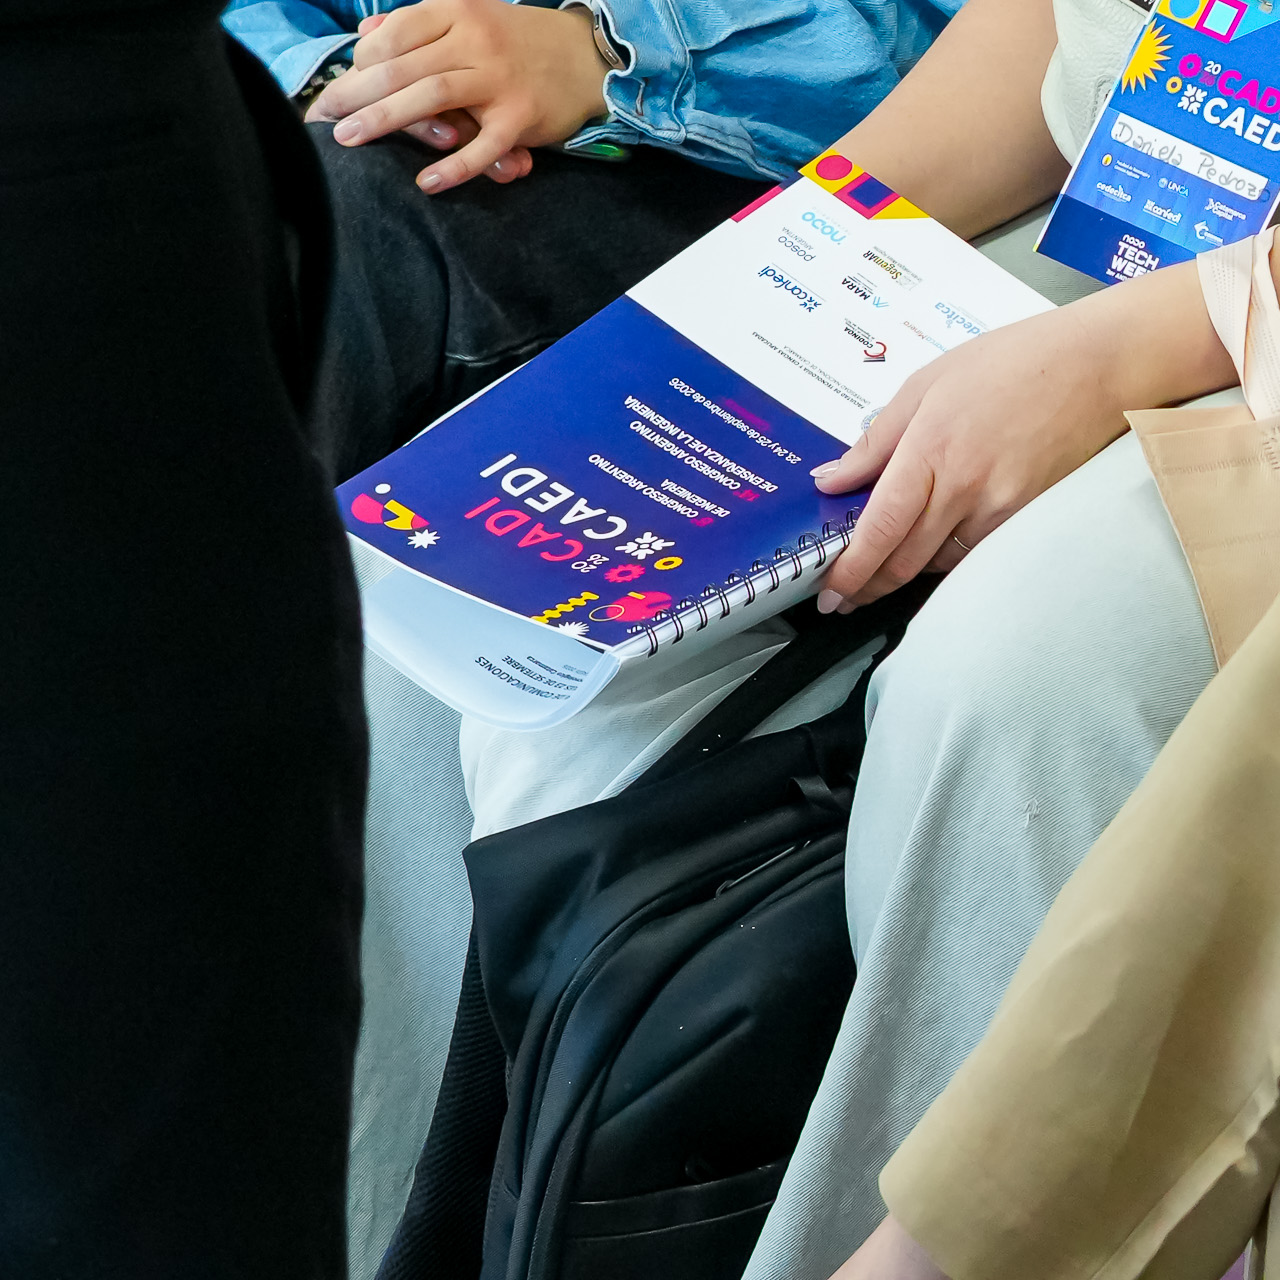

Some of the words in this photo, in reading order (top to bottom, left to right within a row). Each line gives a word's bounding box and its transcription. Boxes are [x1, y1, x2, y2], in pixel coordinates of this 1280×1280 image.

[1204, 60, 1221, 75] 20
[1115, 121, 1183, 166] Daniela
[1168, 182, 1189, 197] UNCA
[1110, 255, 1152, 277] WEE
[1118, 241, 1160, 270] TECH
[757, 265, 808, 300] confedi
[842, 277, 870, 300] MARA
[934, 301, 983, 336] decitca
[844, 326, 873, 348] CODINOA
[902, 320, 948, 353] marcaMinera
[668, 376, 695, 396] 2026
[692, 391, 706, 402] de
[623, 394, 681, 436] INGENIERÍA
[703, 398, 750, 430] septiembre
[629, 418, 689, 457] ARGENTINO
[676, 429, 694, 444] LA
[747, 426, 760, 438] de
[755, 434, 772, 447] 25
[688, 438, 707, 452] DE
[772, 443, 789, 457] 24
[588, 452, 648, 489] ARGENTINO
[683, 453, 741, 490] CONGRESO
[703, 446, 764, 486] ENSEÑANZA
[479, 453, 626, 539] CAEDI
[659, 477, 717, 511] INGENIERÍA
[756, 479, 778, 493] DE
[641, 485, 699, 519] CONGRESO
[711, 505, 730, 518] DE
[464, 496, 583, 562] CADI
[571, 561, 596, 573] 20
[586, 553, 609, 565] 26
[474, 656, 554, 696] COMUNICACIONES
[501, 655, 546, 681] SETIEMBRE
[542, 678, 556, 686] DE
